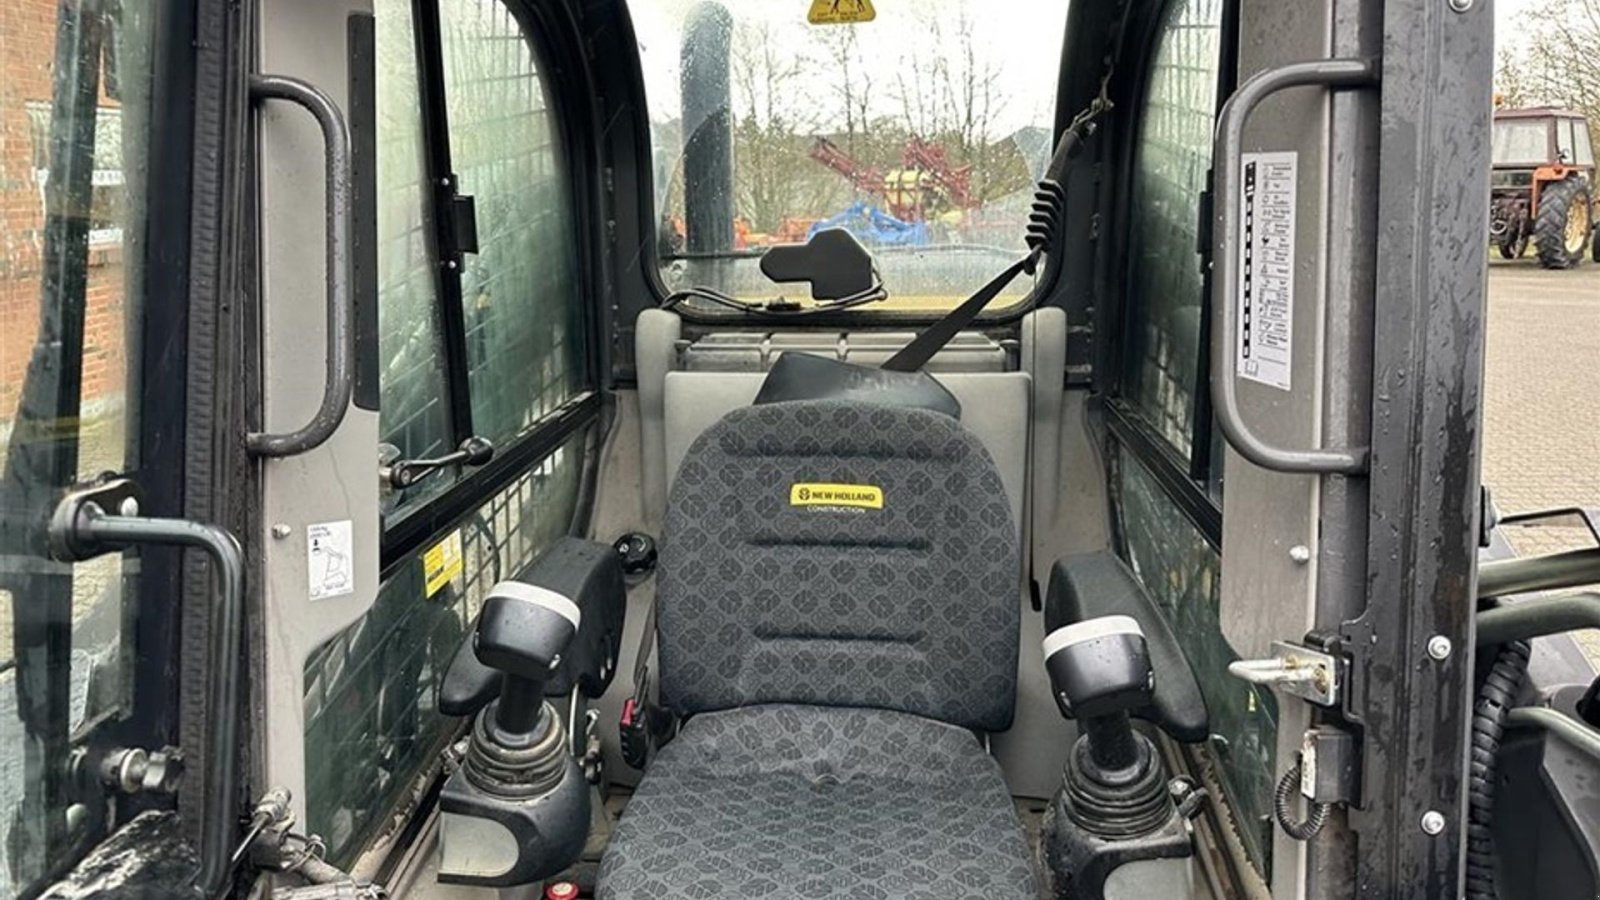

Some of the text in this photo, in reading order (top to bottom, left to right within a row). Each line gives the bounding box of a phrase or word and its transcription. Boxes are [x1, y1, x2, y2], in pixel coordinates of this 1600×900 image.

[812, 491, 875, 502] NEW HOLLAND
[807, 505, 866, 514] CONSTRUCTION
